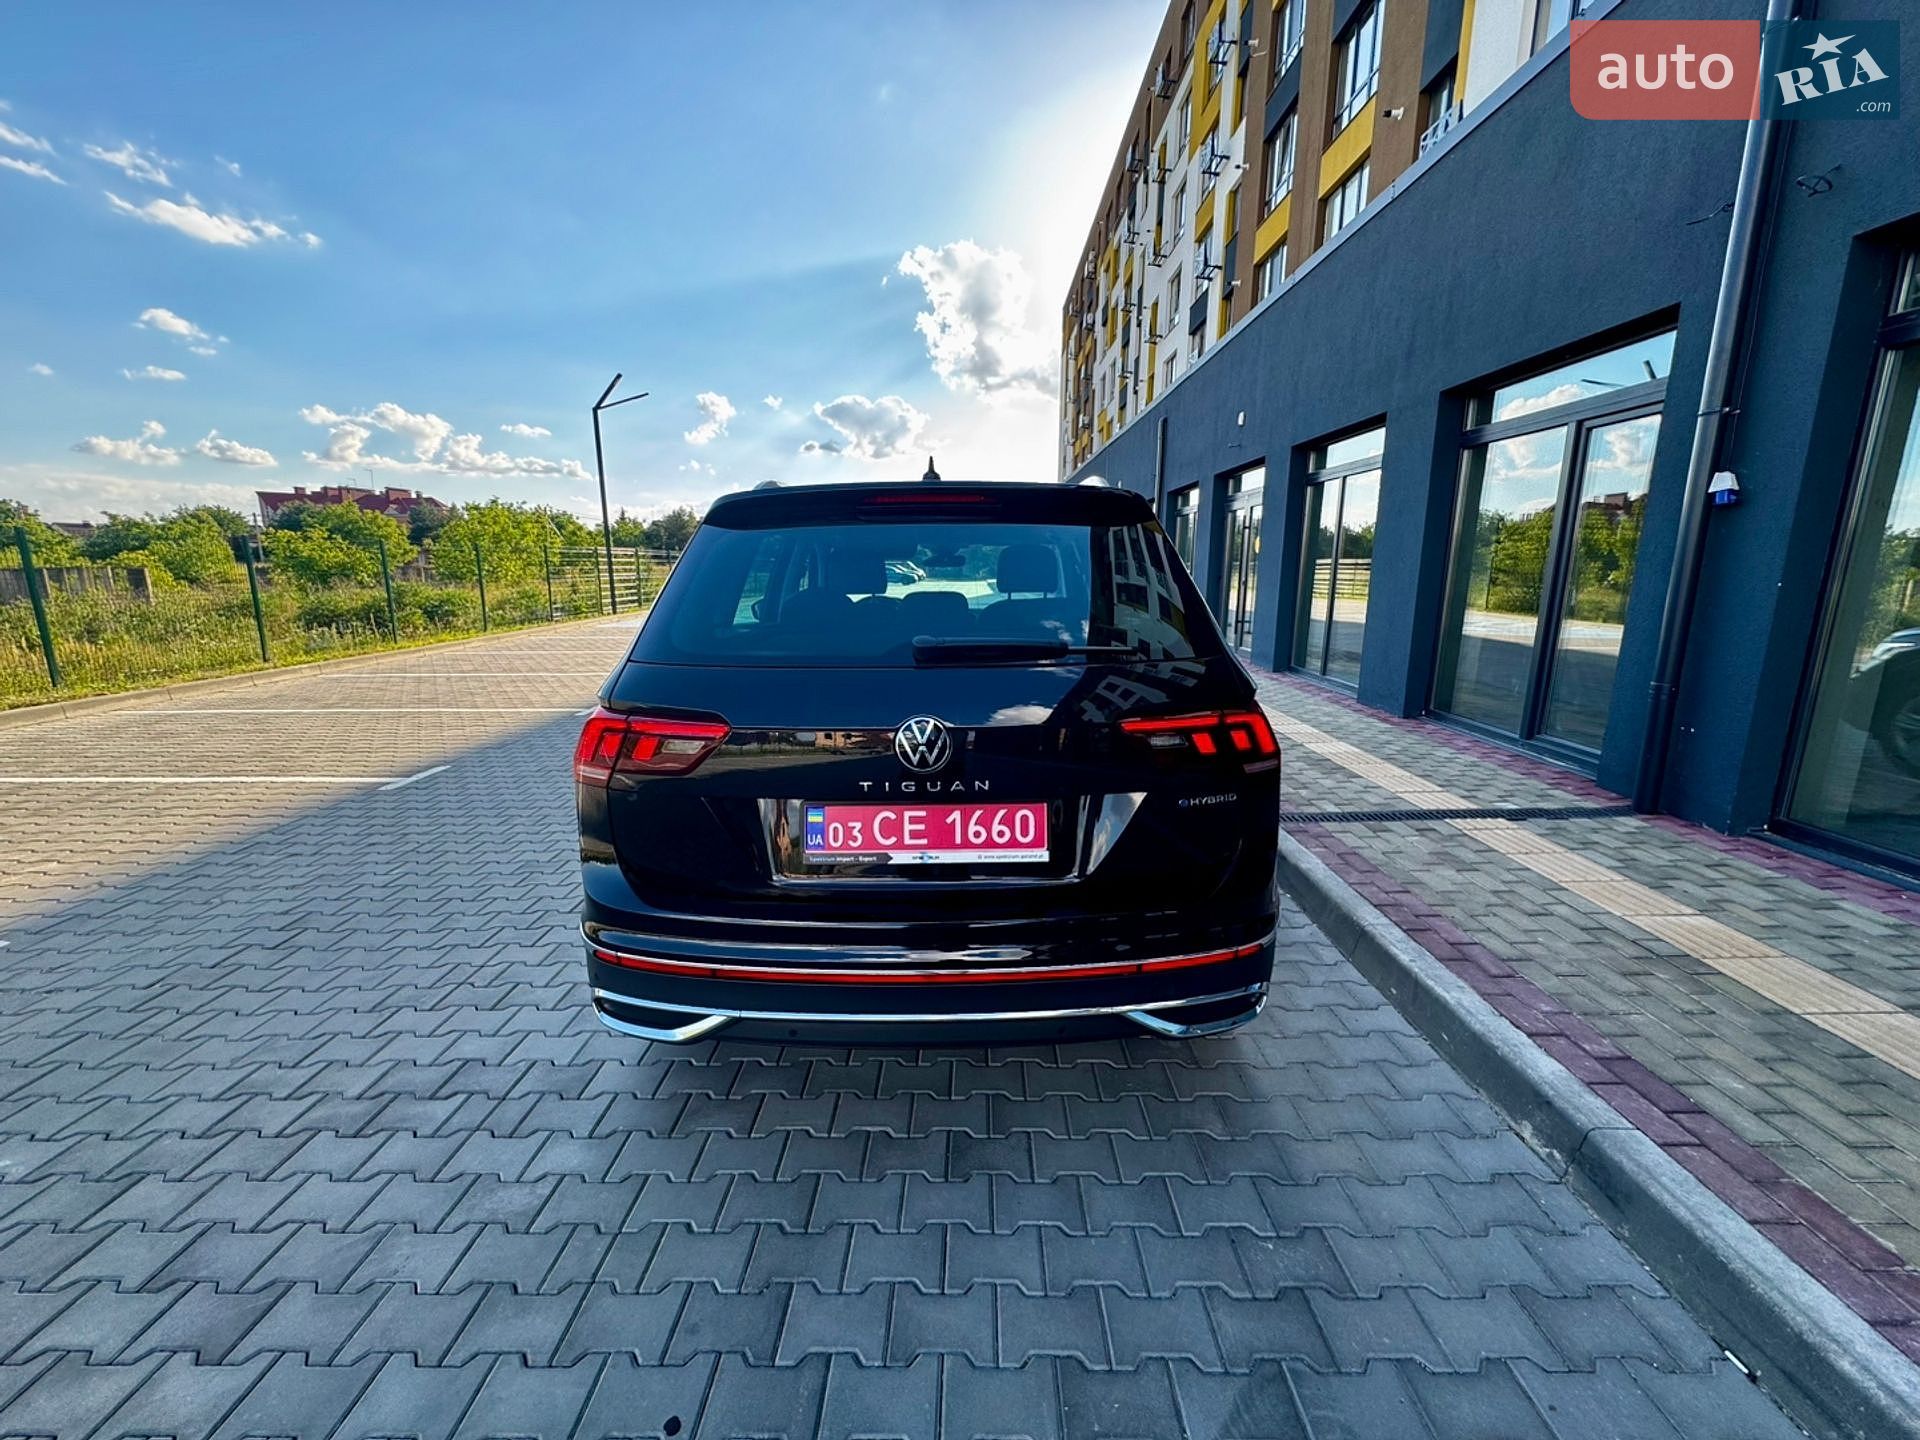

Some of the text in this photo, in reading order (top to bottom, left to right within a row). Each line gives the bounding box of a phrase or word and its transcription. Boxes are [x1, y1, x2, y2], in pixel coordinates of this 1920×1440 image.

[858, 780, 990, 793] TIGUAN
[807, 808, 1036, 848] UA 03 CE 1660
